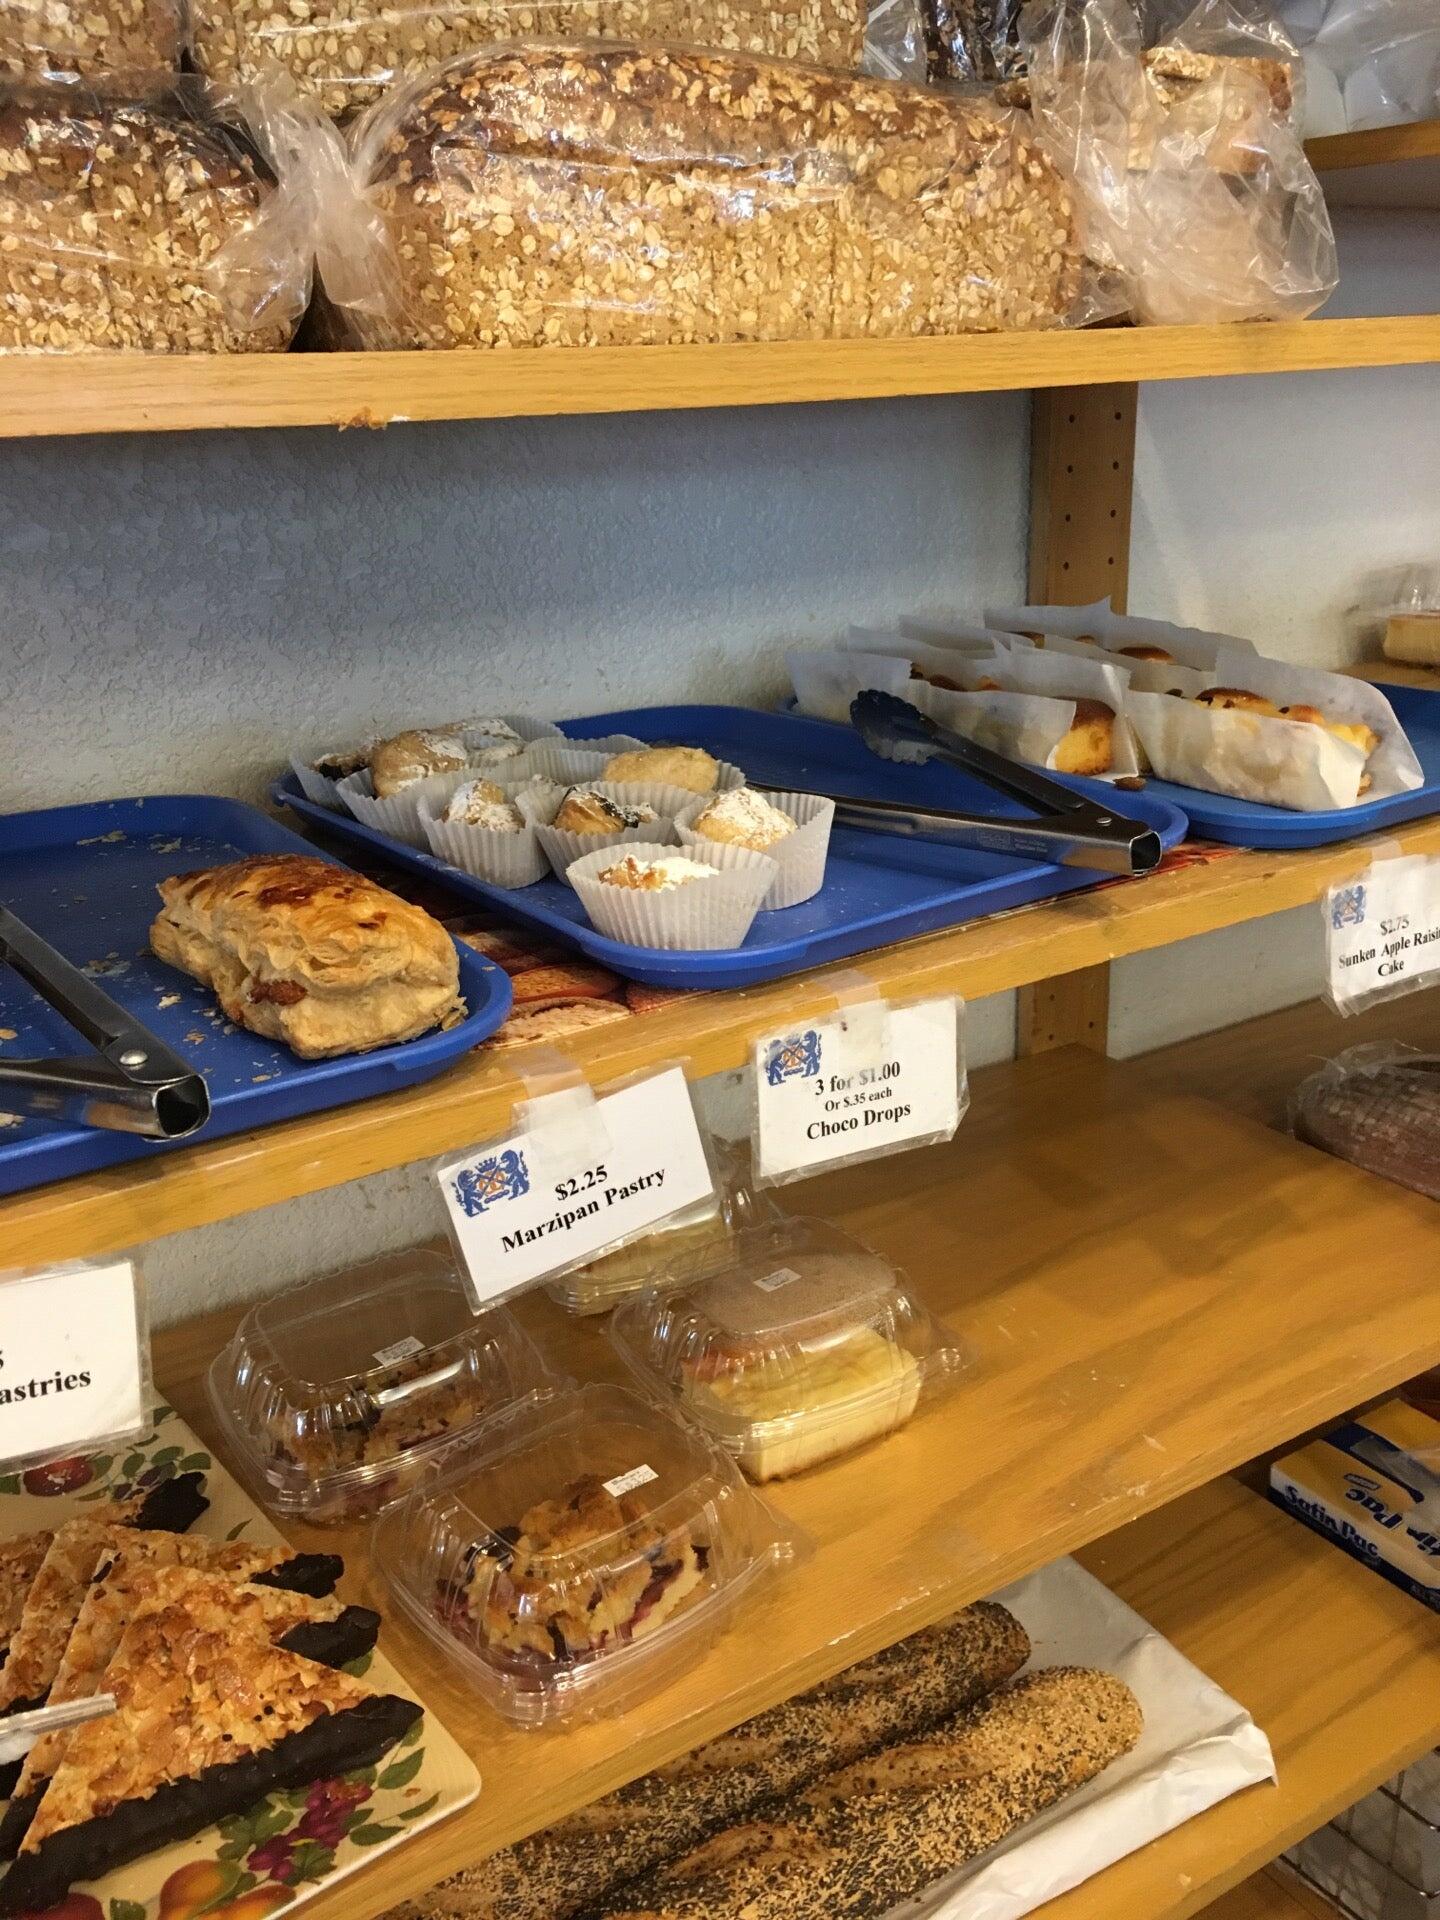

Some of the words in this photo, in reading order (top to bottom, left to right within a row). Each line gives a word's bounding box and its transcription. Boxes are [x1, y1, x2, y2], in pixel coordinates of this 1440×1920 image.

[1338, 947, 1376, 969] Sunken
[1381, 936, 1411, 958] Apple
[1413, 926, 1440, 947] Raisi
[1377, 959, 1405, 977] Cake
[815, 1078, 825, 1096] 3
[830, 1075, 854, 1092] for
[859, 1061, 901, 1086] $1.00
[824, 1100, 840, 1112] Or
[843, 1092, 866, 1108] $.35
[868, 1086, 892, 1102] each
[806, 1117, 859, 1140] Choco
[863, 1102, 912, 1128] Drops
[554, 1164, 609, 1202] $2.25
[501, 1199, 601, 1253] Marzipan
[604, 1167, 668, 1207] Pastry
[0, 1370, 92, 1407] astries
[1284, 1485, 1338, 1530] Satin
[1341, 1519, 1379, 1556] Pac
[1345, 1488, 1403, 1530] Pac
